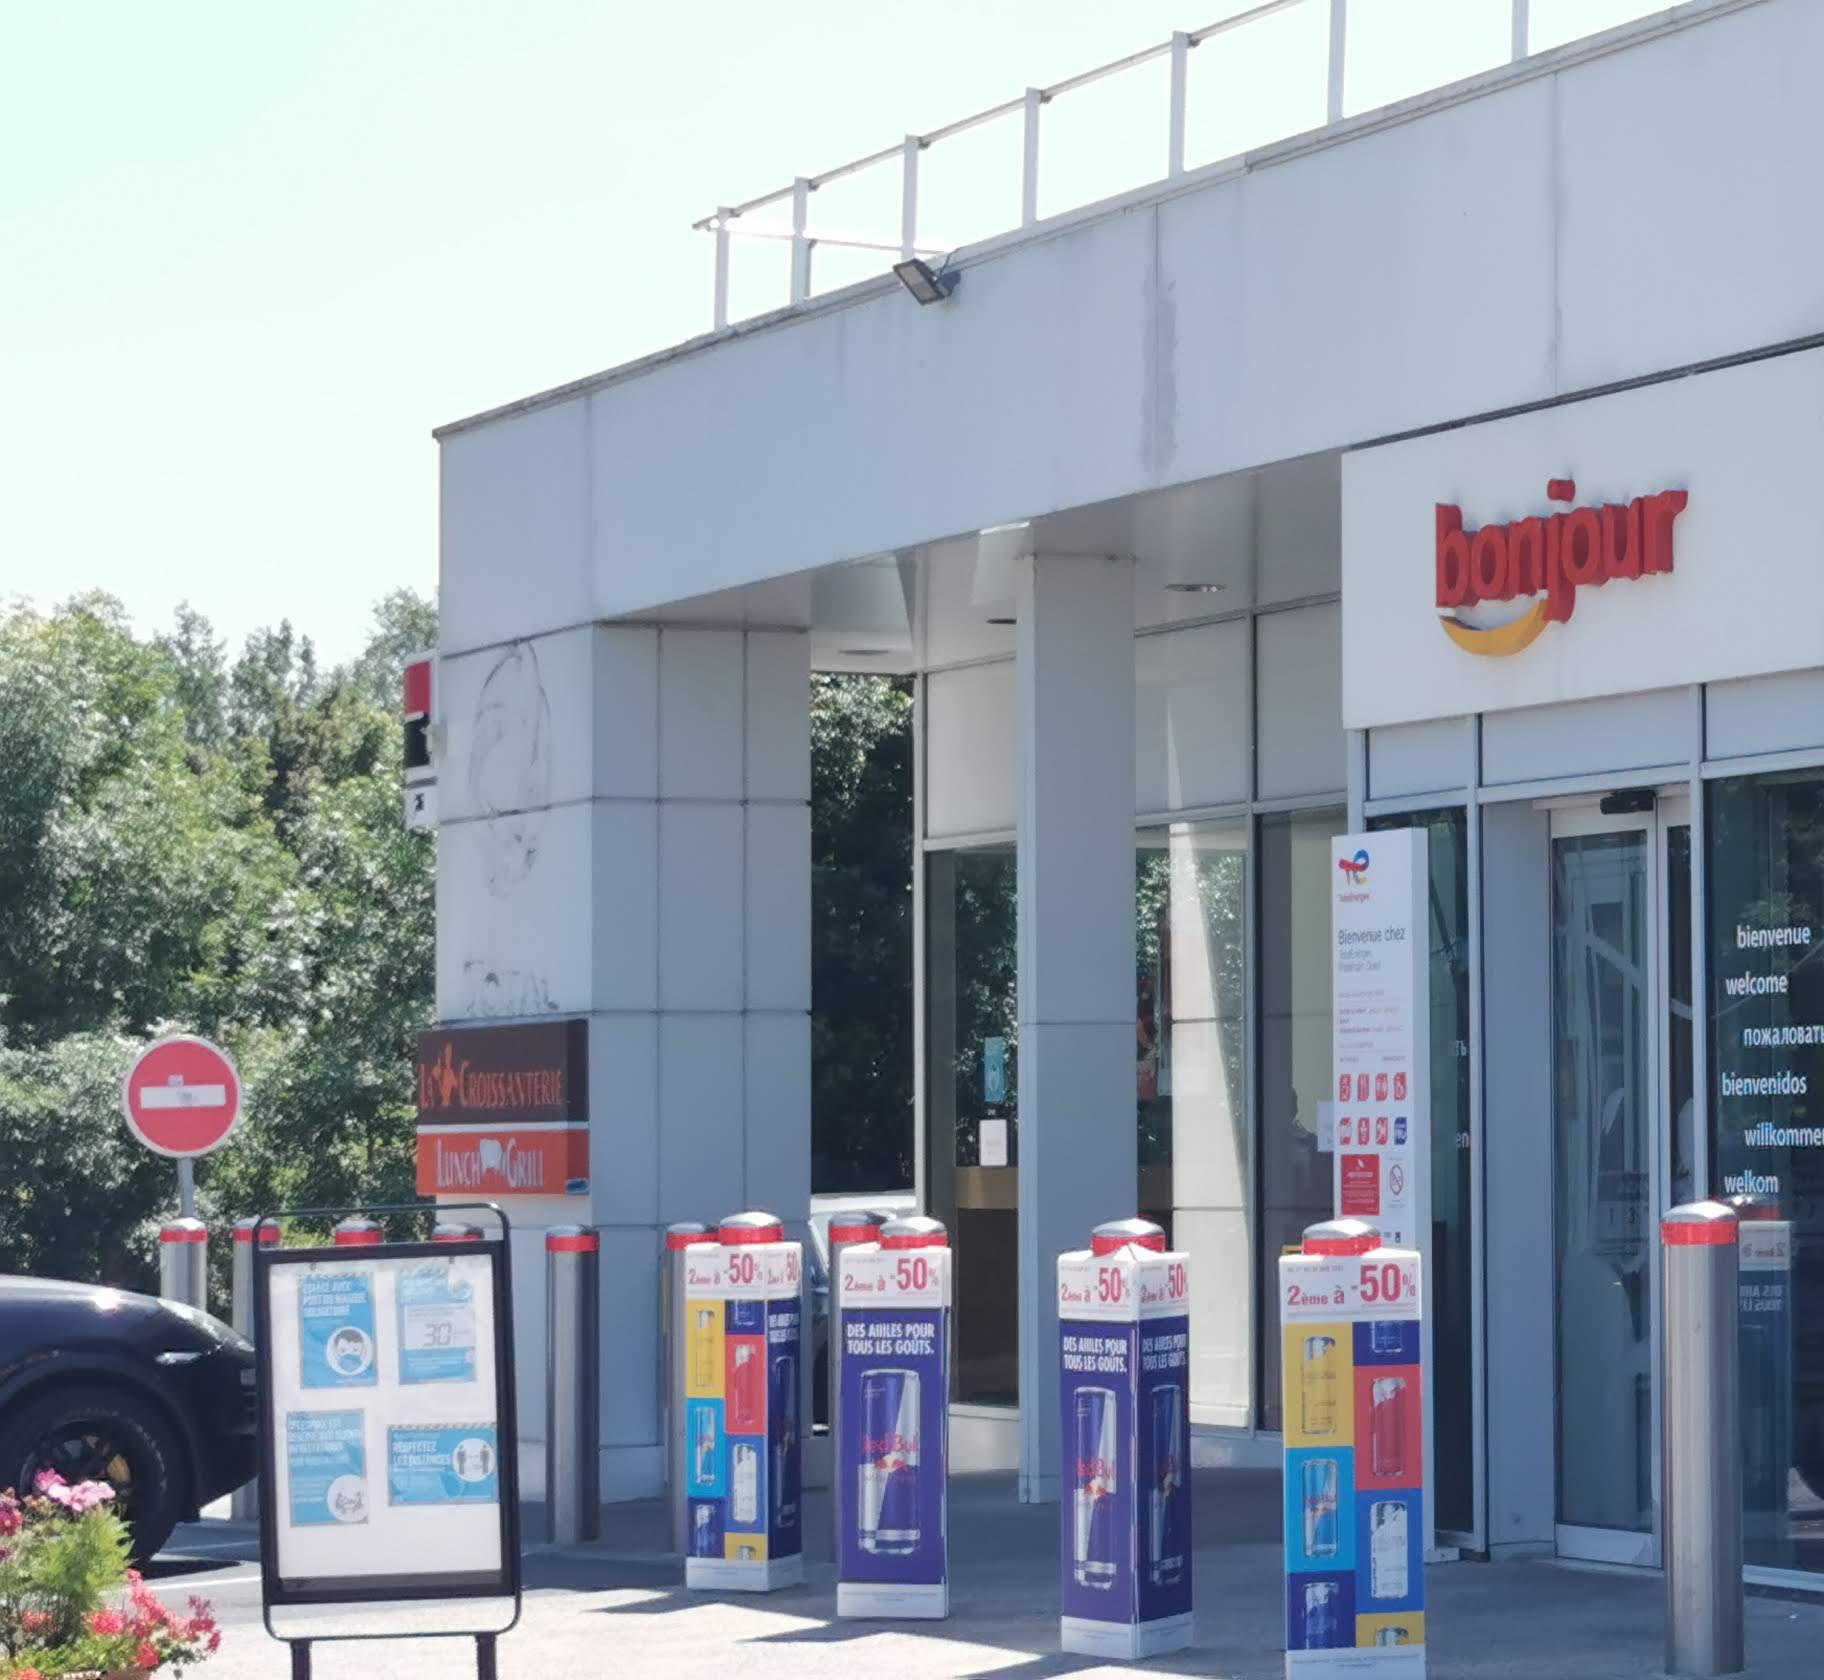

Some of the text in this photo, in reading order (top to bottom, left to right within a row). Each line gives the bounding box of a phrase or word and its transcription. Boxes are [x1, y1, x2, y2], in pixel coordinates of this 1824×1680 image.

[1435, 477, 1689, 624] bonjour
[1338, 925, 1406, 945] Bienvenue chez
[1736, 925, 1811, 949] bienvenue
[1725, 971, 1789, 995] welcome
[458, 1060, 565, 1108] CROISSANTERIE
[1722, 1071, 1808, 1097] bienvenidos
[436, 1139, 481, 1188] LUNCH
[1724, 1170, 1779, 1194] welkom
[1287, 1284, 1329, 1306] 2ème
[1333, 1284, 1345, 1305] à
[1350, 1263, 1417, 1303] -50%
[423, 1323, 452, 1347] 30
[847, 1323, 866, 1338] DES
[905, 1323, 935, 1339] POUR
[847, 1340, 873, 1355] TOUS
[876, 1340, 892, 1355] LES
[1063, 1336, 1078, 1352] DES
[1105, 1338, 1128, 1355] POUR
[1064, 1354, 1083, 1371] TOUS
[1084, 1356, 1096, 1372] LES
